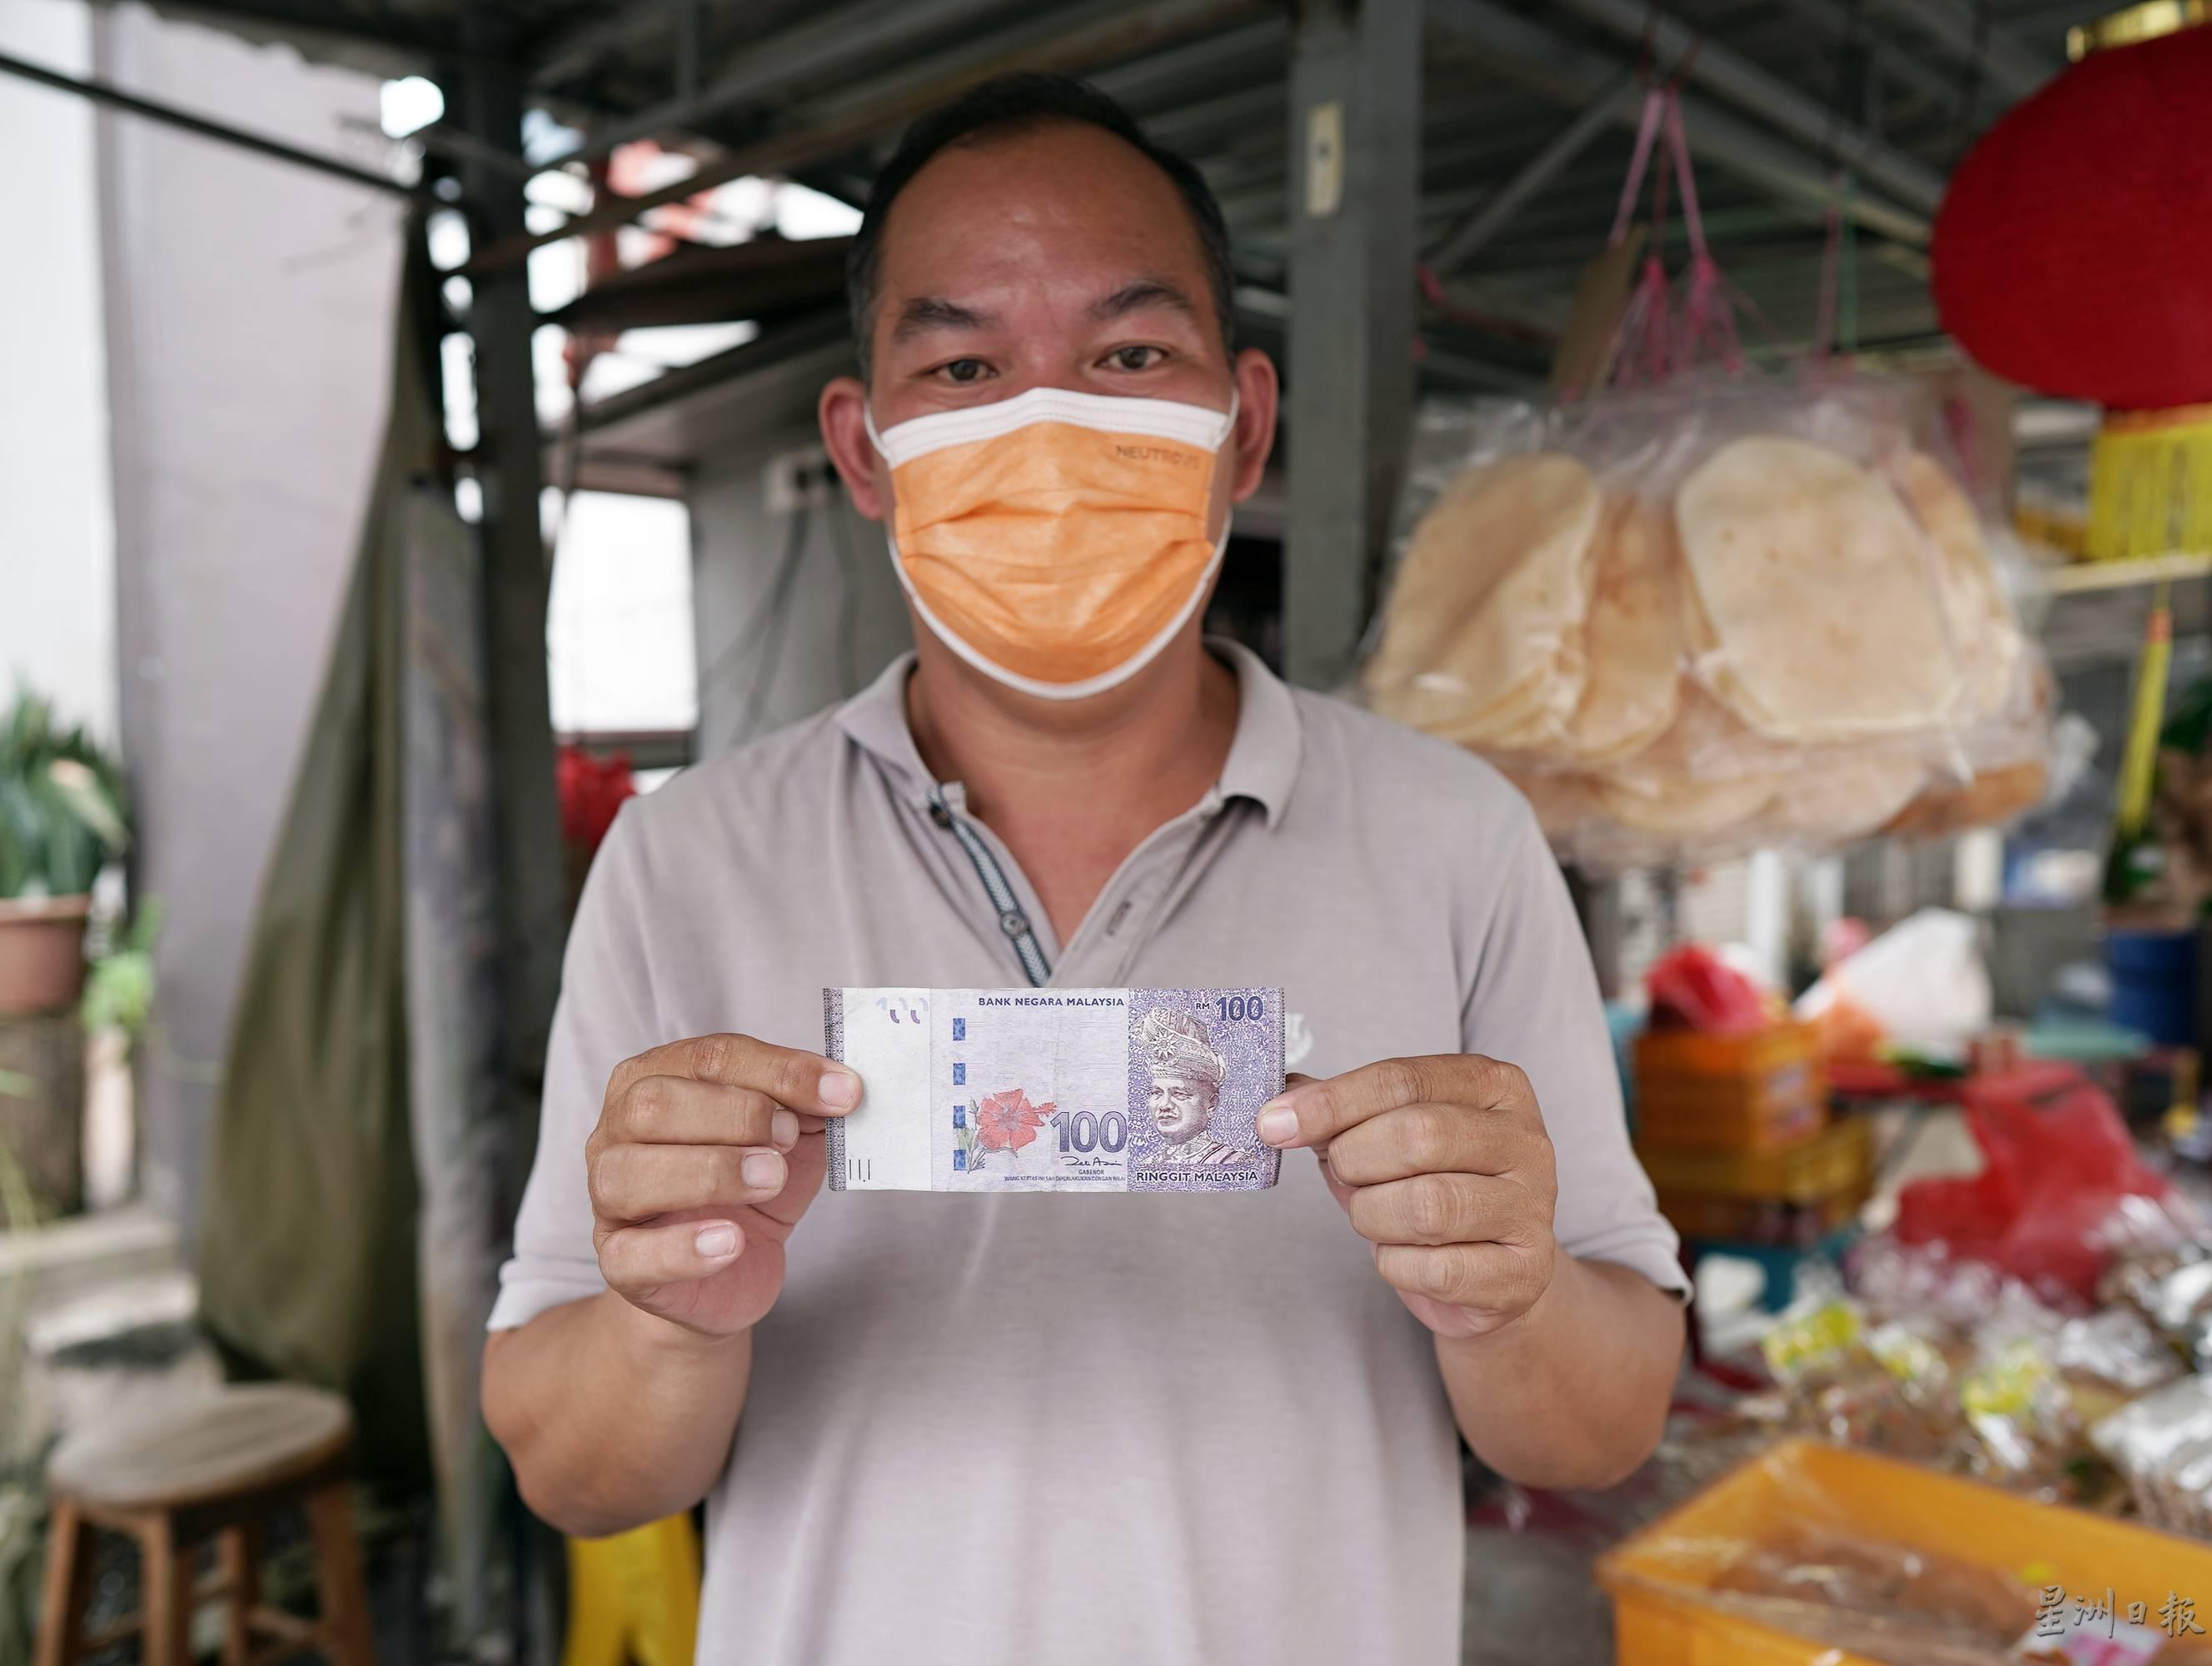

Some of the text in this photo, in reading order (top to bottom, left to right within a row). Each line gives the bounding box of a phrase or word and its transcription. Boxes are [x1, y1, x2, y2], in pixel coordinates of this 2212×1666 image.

[979, 998, 1124, 1006] BANK NEGARA MALAYSIA
[1215, 995, 1263, 1021] 100
[1050, 1110, 1128, 1153] 100
[1136, 1171, 1258, 1181] RINGGIT MALAYSIA
